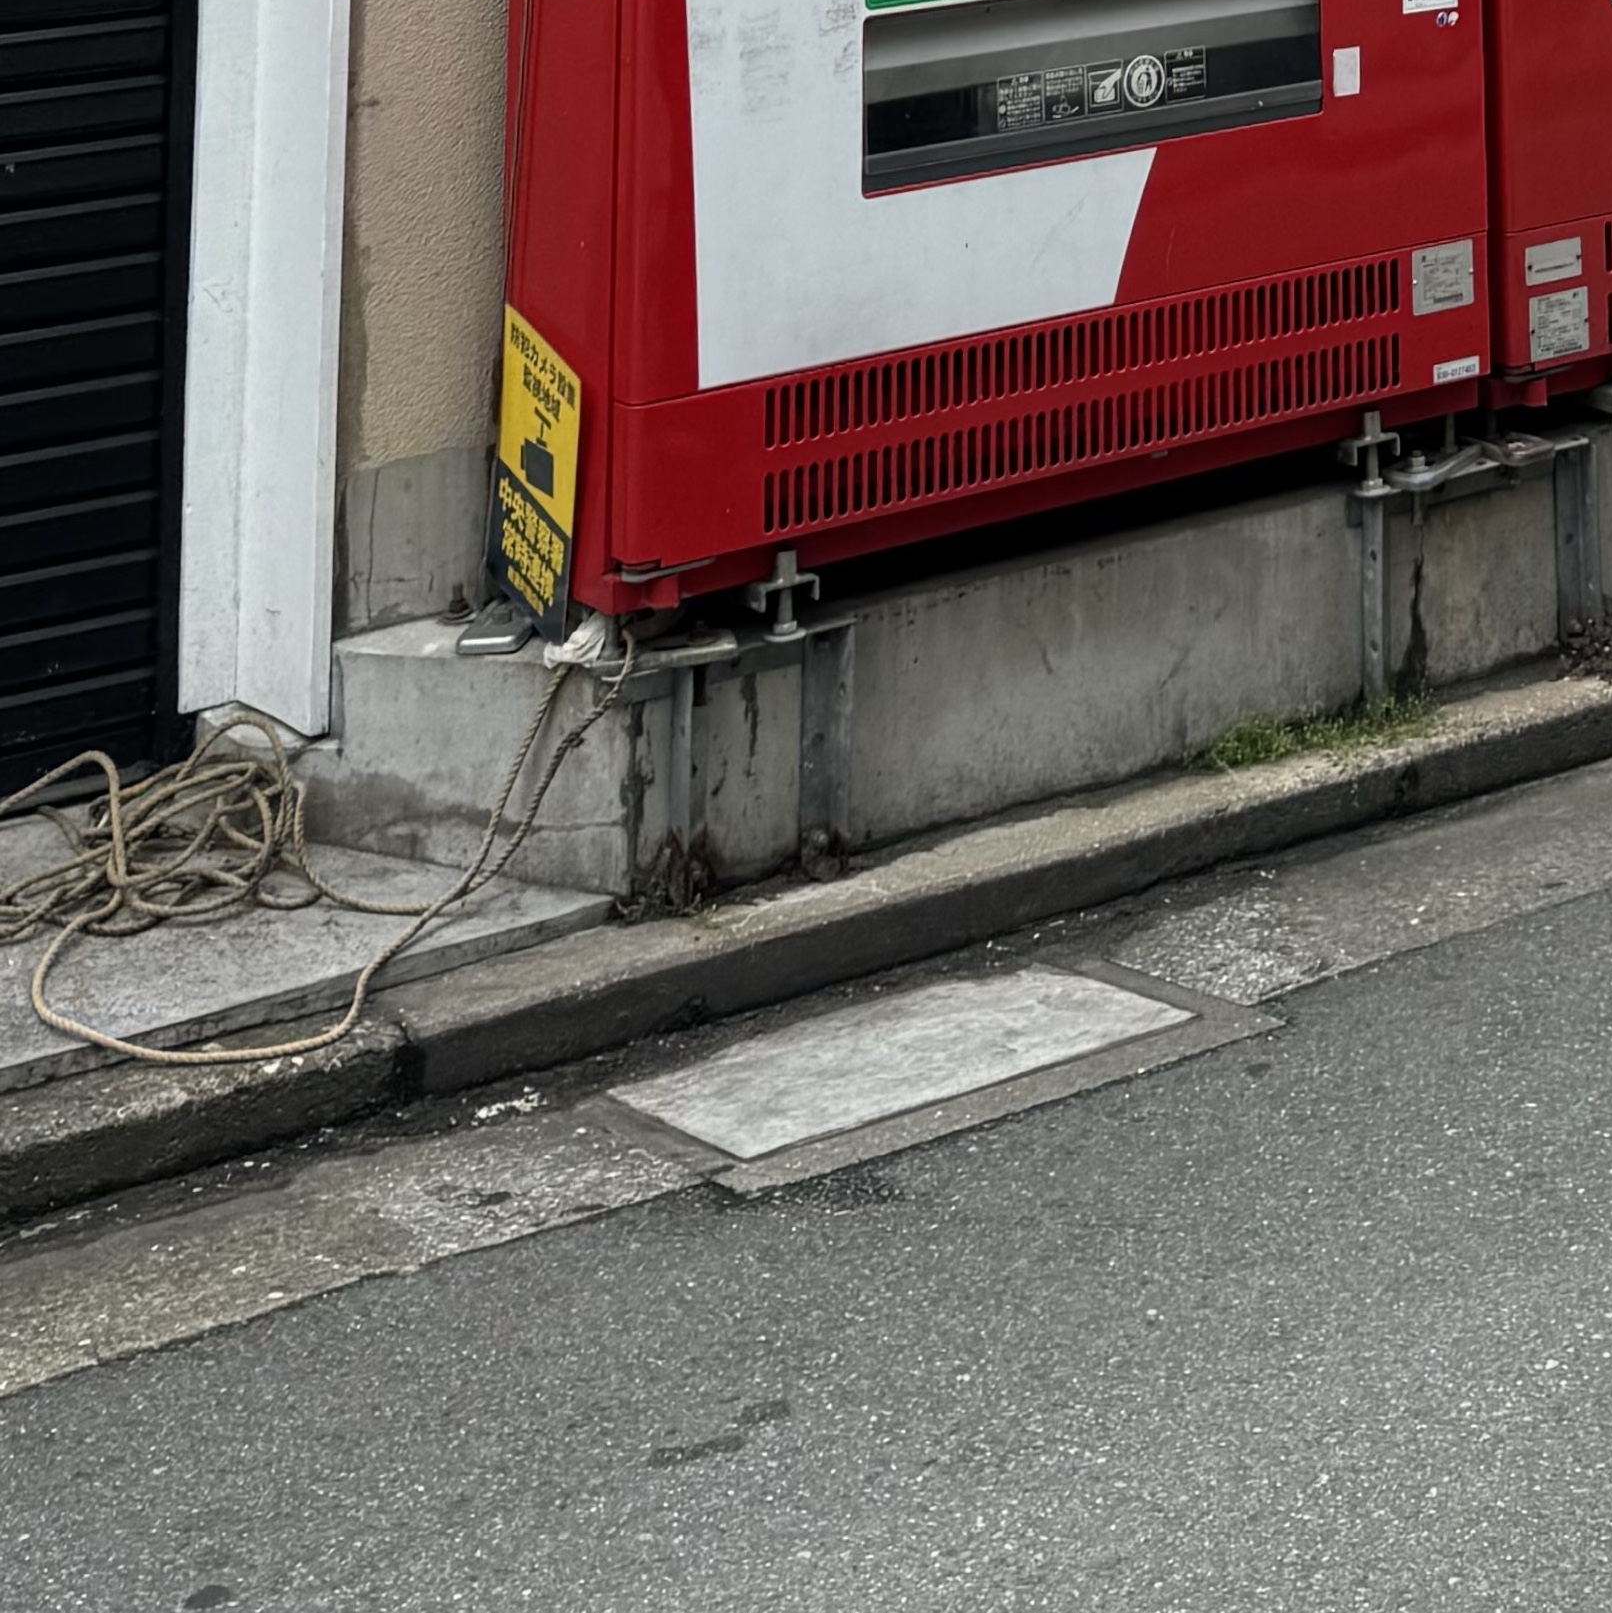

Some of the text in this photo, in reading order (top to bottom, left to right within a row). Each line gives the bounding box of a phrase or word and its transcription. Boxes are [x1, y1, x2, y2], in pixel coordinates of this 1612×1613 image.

[510, 321, 576, 411] 防犯カメラ設置
[499, 476, 565, 576] 中央警察署
